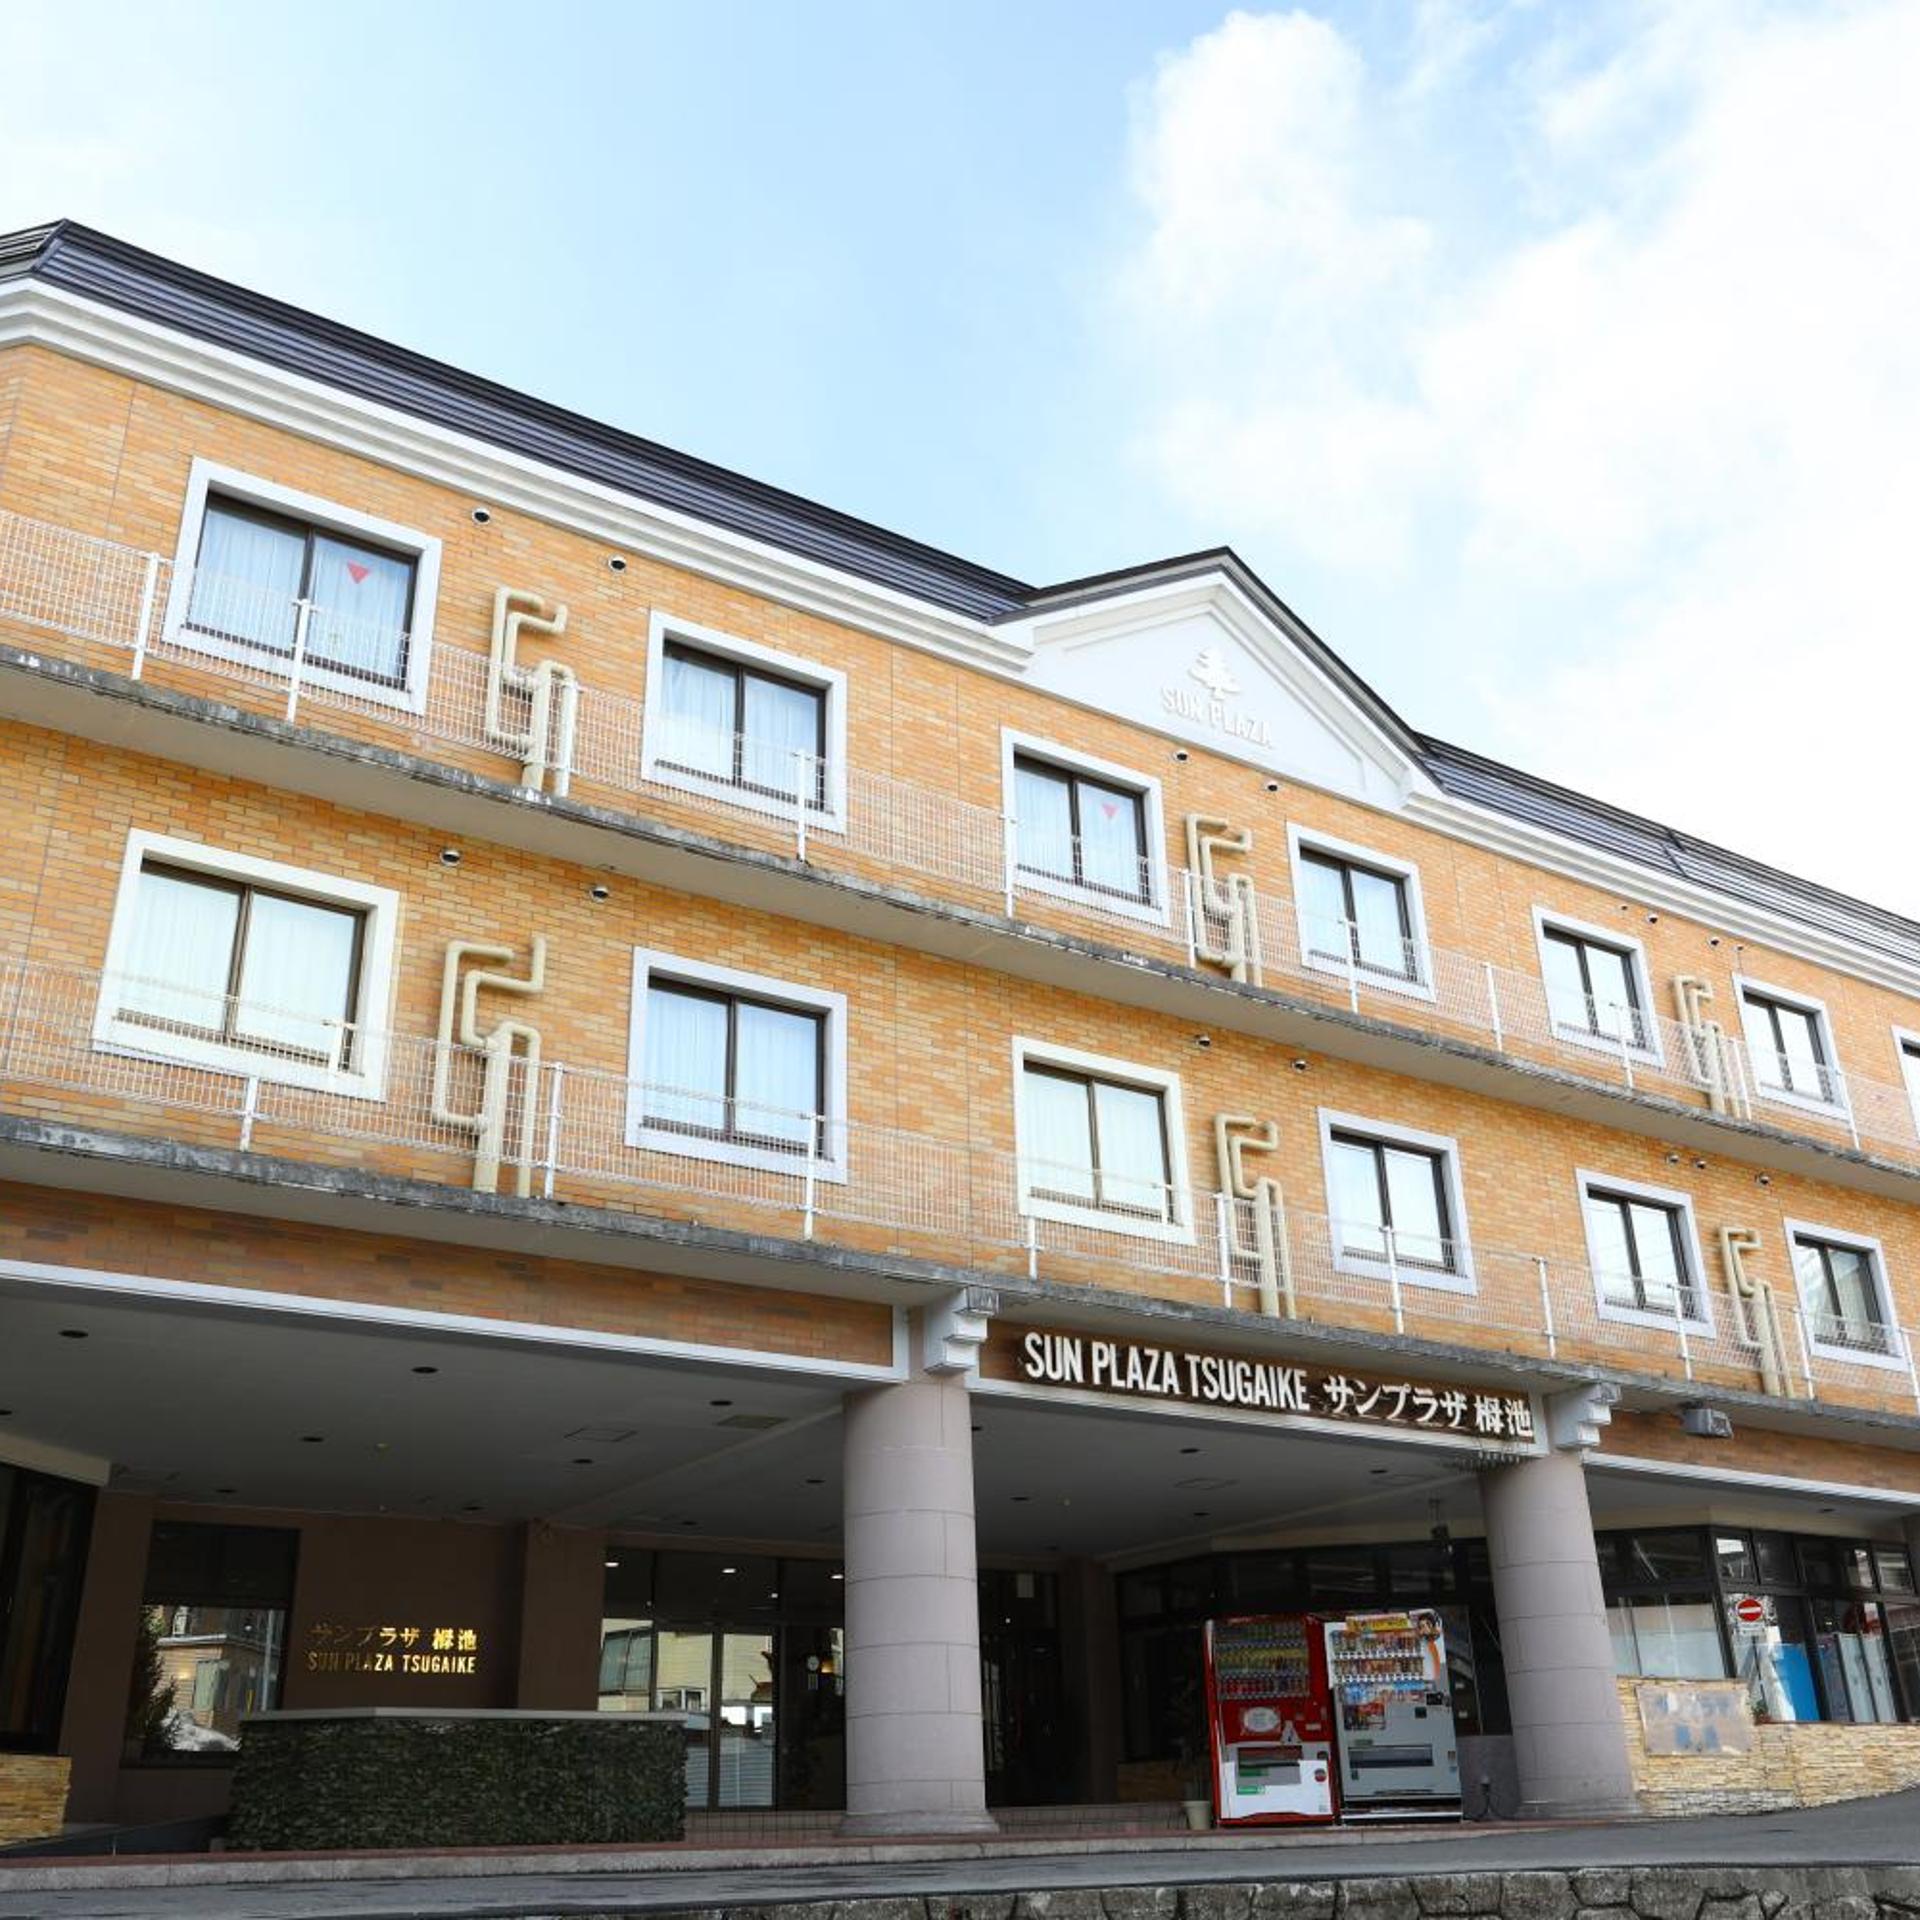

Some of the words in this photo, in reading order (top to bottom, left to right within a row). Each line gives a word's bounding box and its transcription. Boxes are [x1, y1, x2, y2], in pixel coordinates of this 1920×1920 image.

[1161, 688, 1202, 723] SUN
[1209, 701, 1273, 748] PLAZA
[1024, 1331, 1084, 1384] SUN
[1091, 1340, 1181, 1396] PLAZA
[1184, 1352, 1311, 1411] TSUGAIKE
[1323, 1375, 1467, 1428] サンプラザ
[1473, 1394, 1534, 1437] 栂池
[308, 1623, 421, 1649] サンプラザ
[307, 1651, 339, 1672] SUN
[345, 1653, 394, 1673] PLAZA
[402, 1655, 477, 1674] TSUGAIKE
